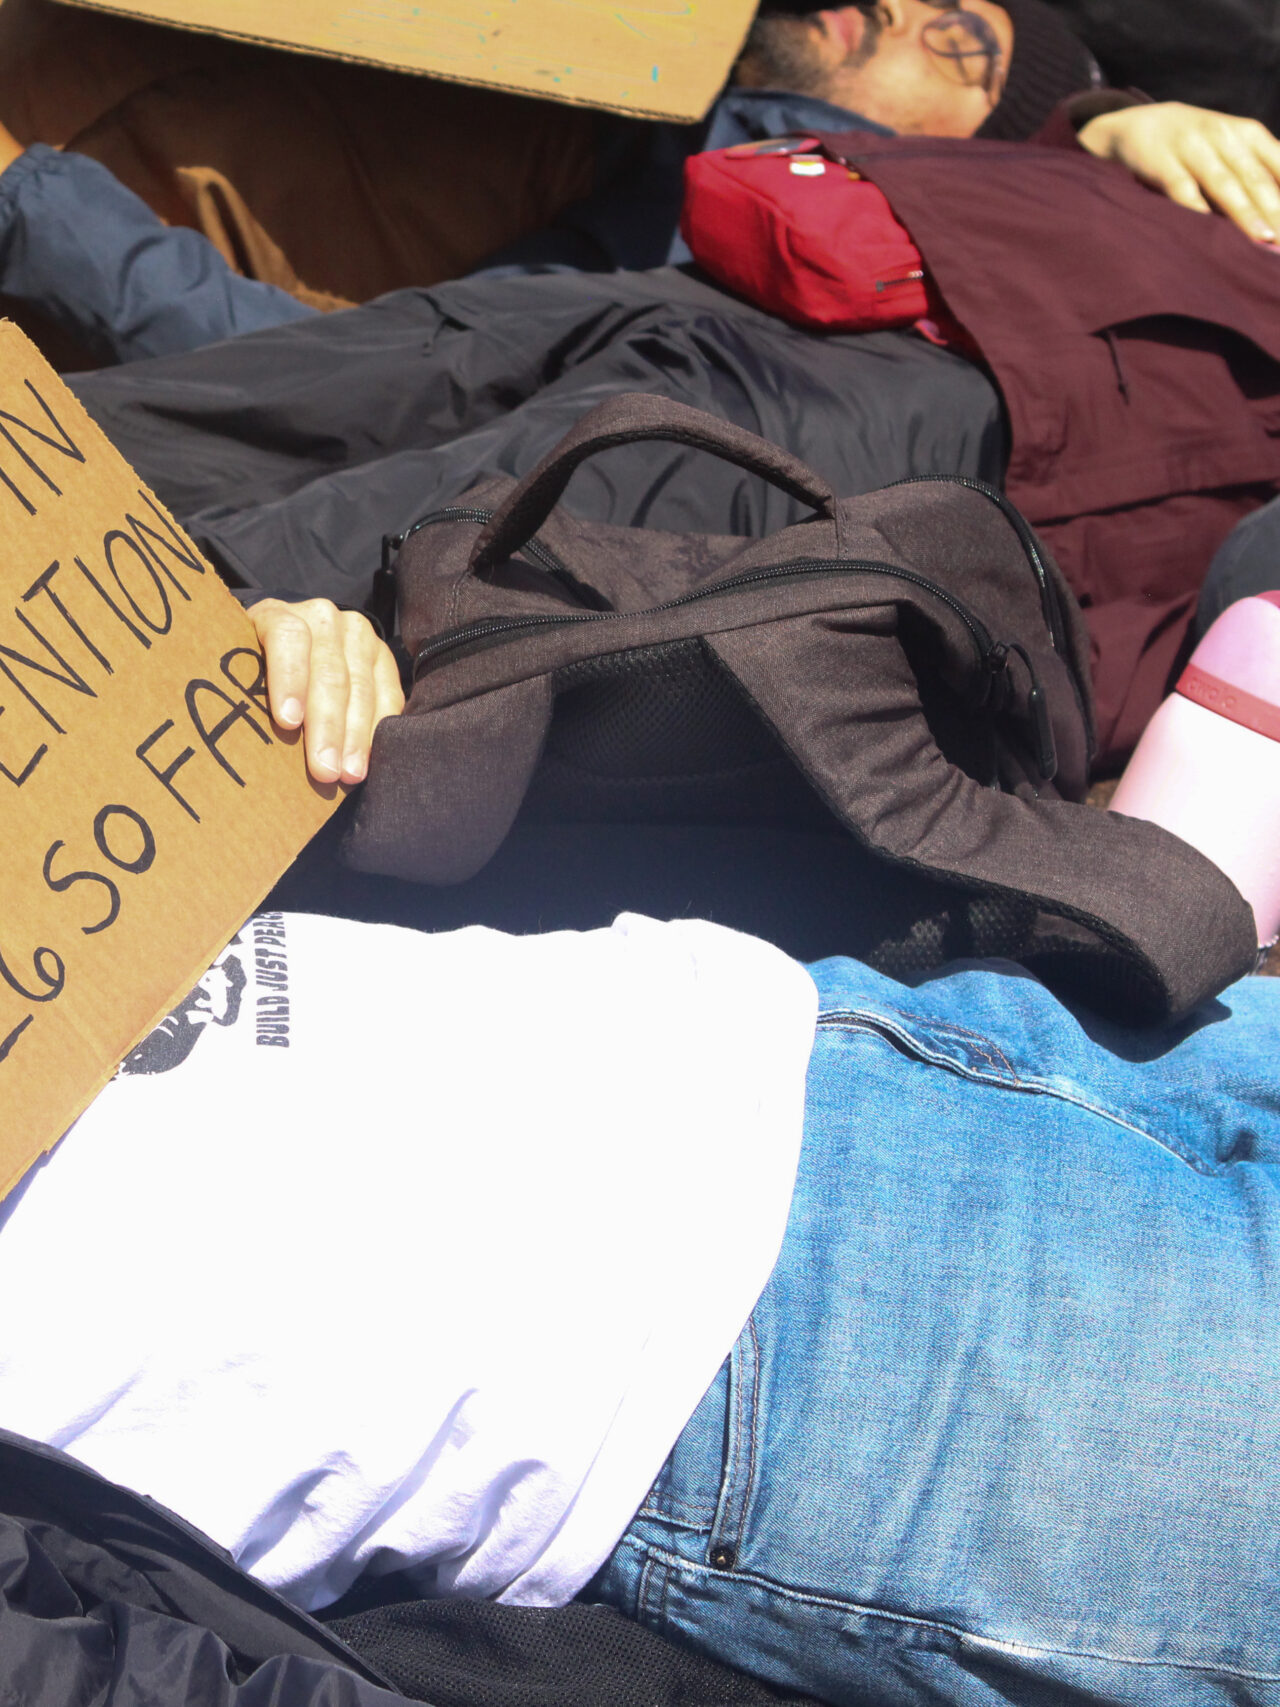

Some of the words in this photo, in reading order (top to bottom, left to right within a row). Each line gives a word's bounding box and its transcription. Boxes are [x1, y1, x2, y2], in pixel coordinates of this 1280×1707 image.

[42, 804, 156, 935] SO
[254, 948, 289, 992] JUST
[255, 995, 290, 1048] BUILD
